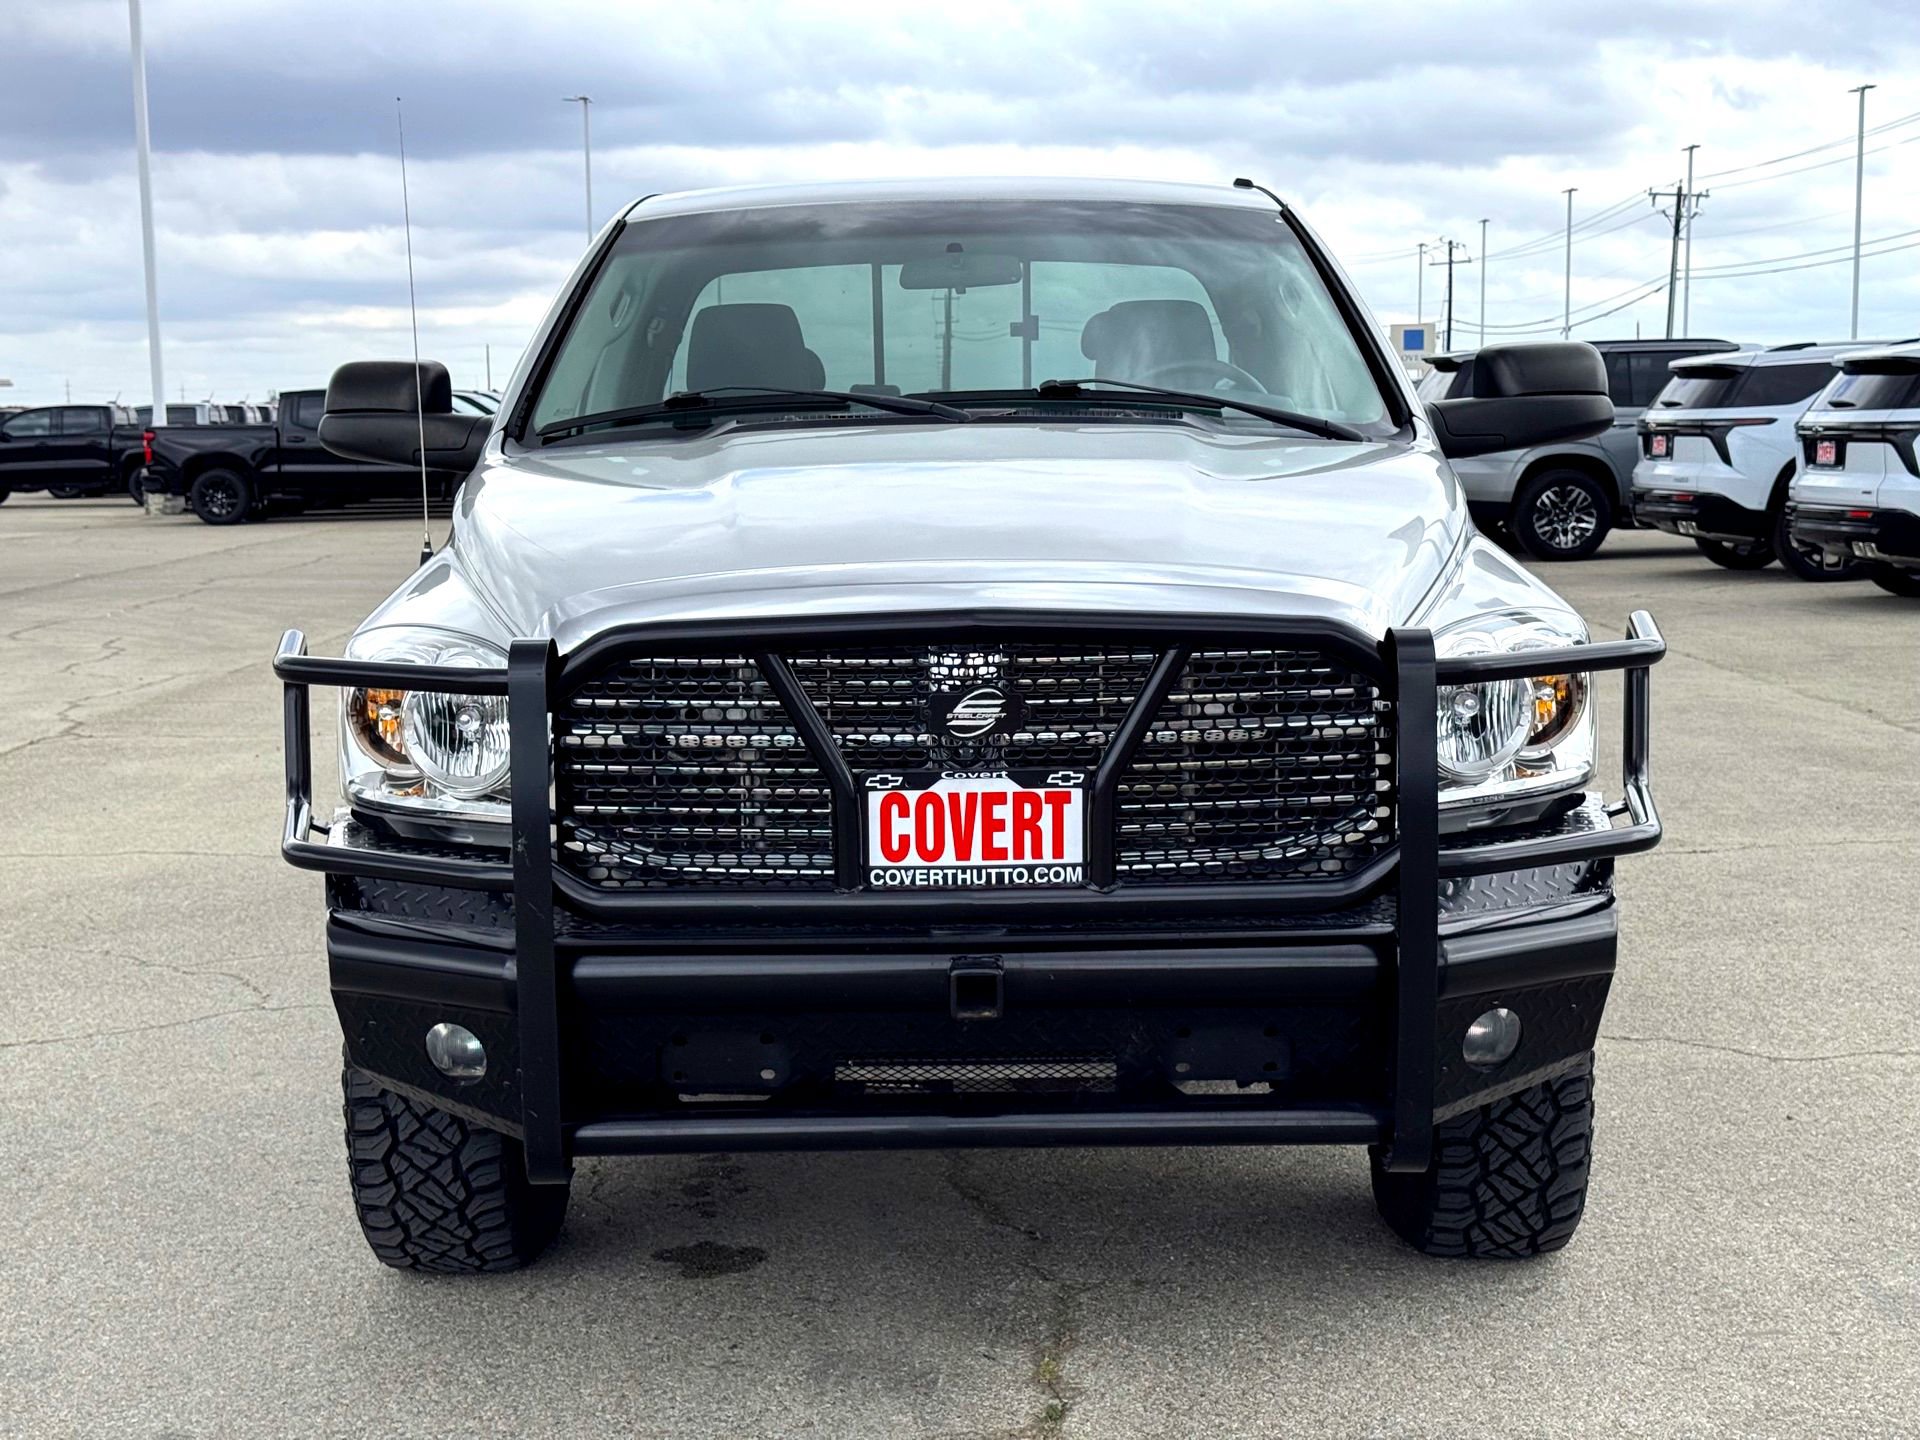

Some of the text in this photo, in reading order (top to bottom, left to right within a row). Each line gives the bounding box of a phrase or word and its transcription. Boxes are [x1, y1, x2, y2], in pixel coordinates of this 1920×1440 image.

[941, 770, 1008, 780] Covert
[880, 790, 1072, 863] COVERT
[870, 866, 1082, 886] COVERTHUTTO.COM
